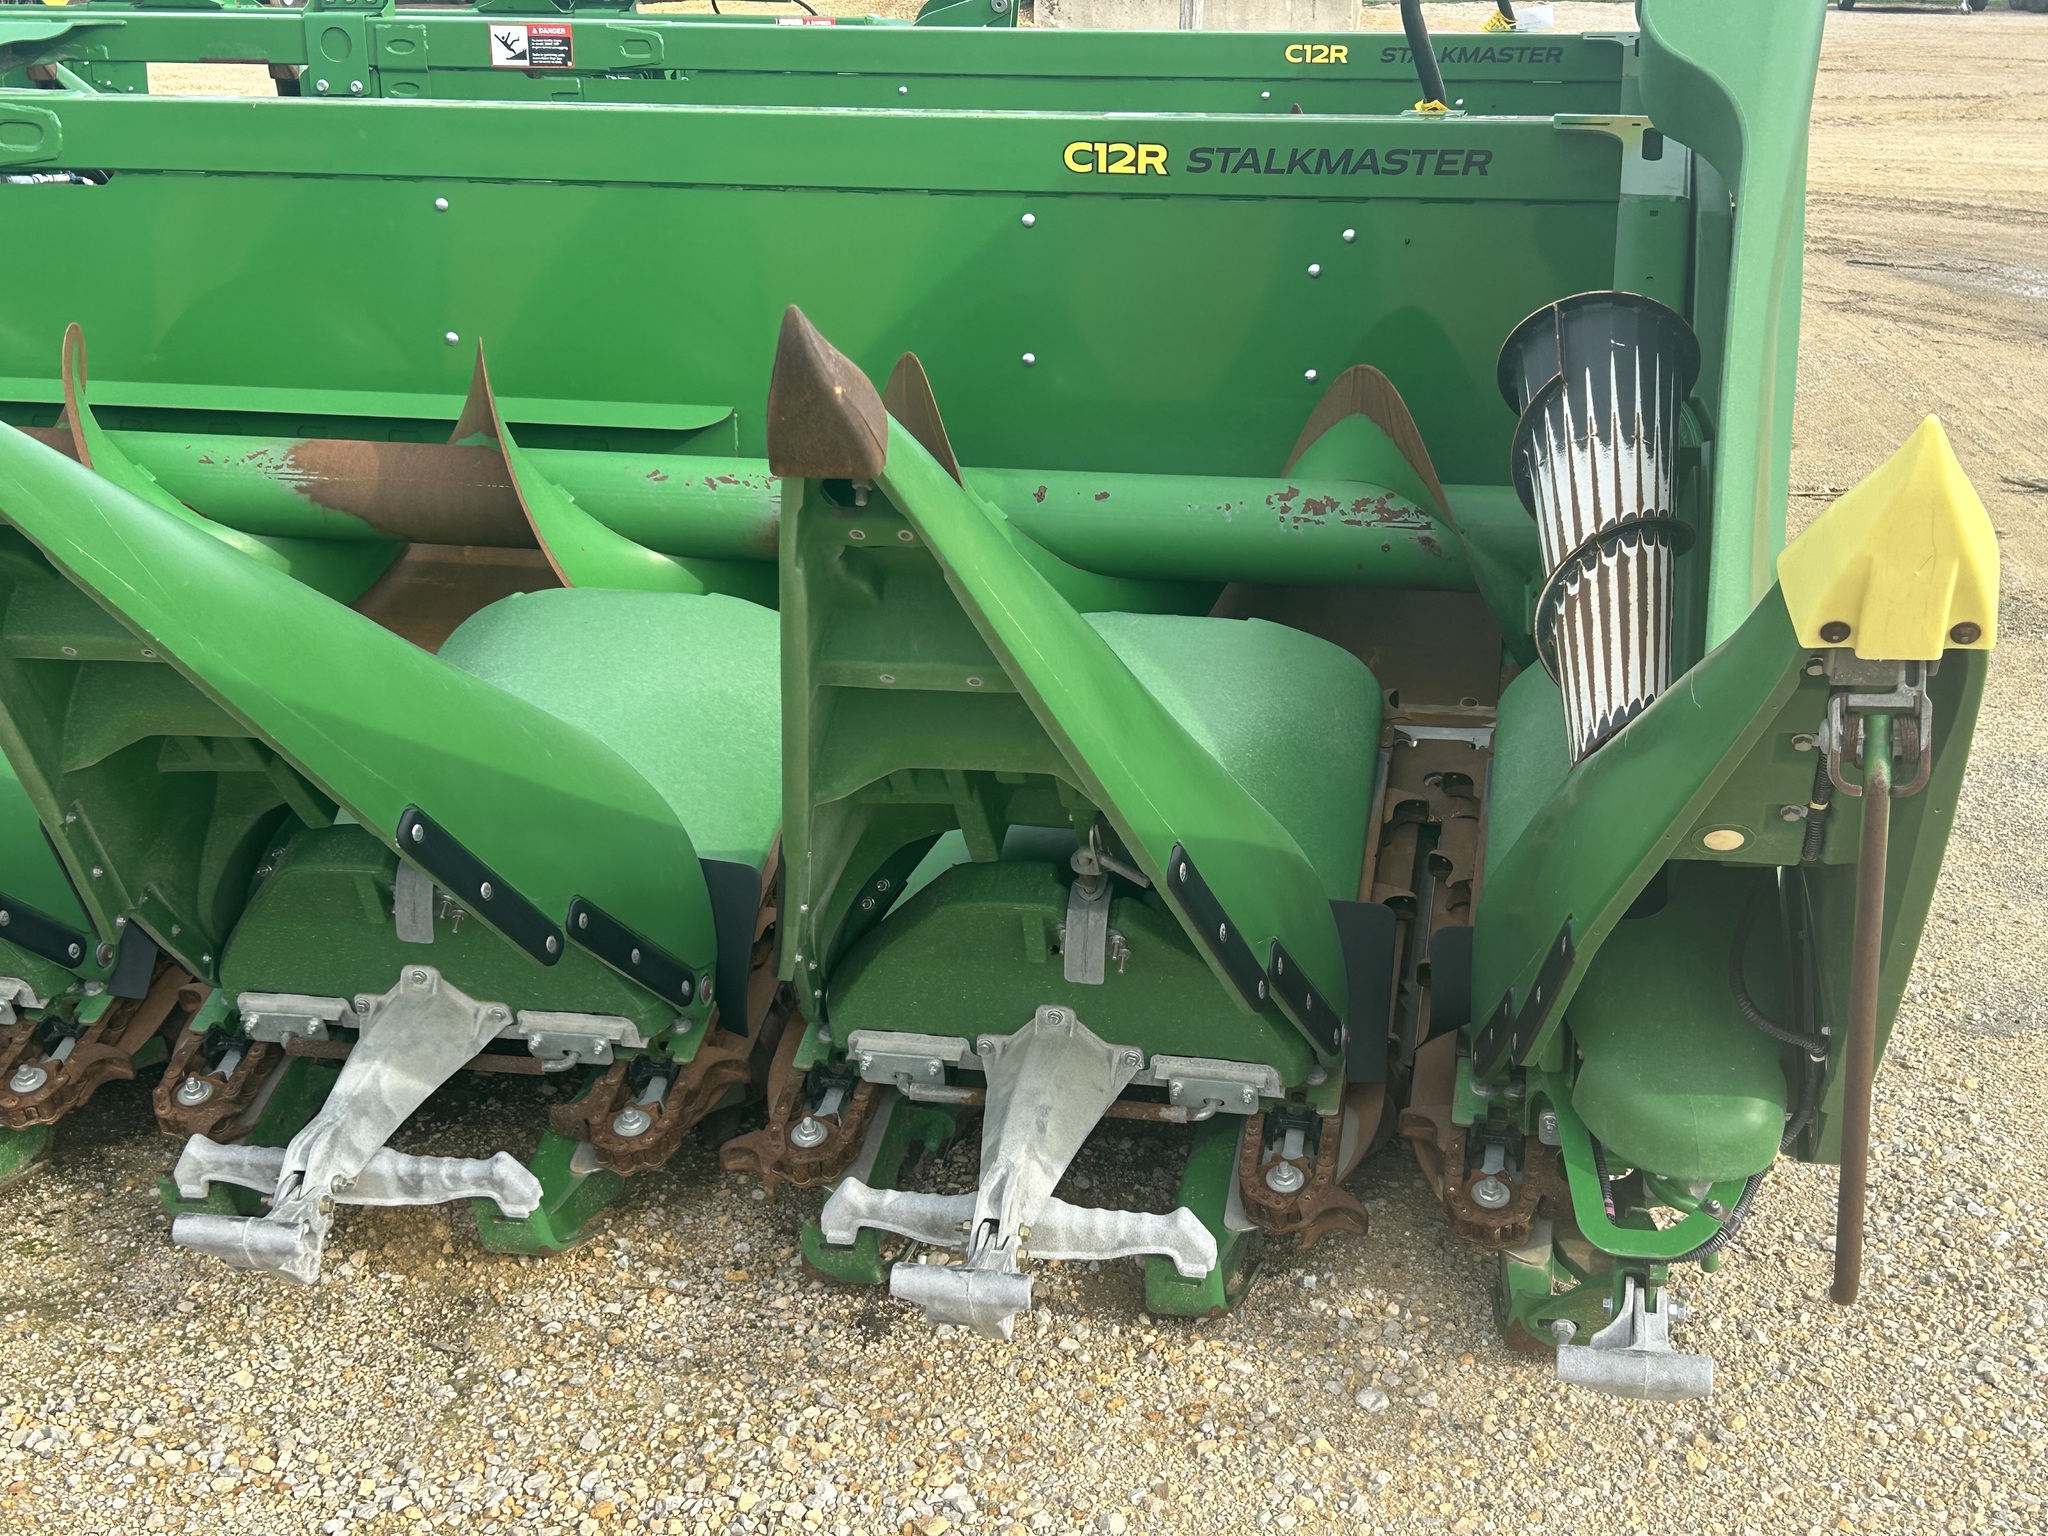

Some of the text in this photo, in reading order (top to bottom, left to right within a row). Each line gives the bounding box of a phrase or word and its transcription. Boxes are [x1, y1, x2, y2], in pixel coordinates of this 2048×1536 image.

[538, 27, 566, 35] DANGER
[1284, 44, 1563, 64] C12R STKMASTER
[1063, 141, 1493, 176] C12R STALKMASTER
